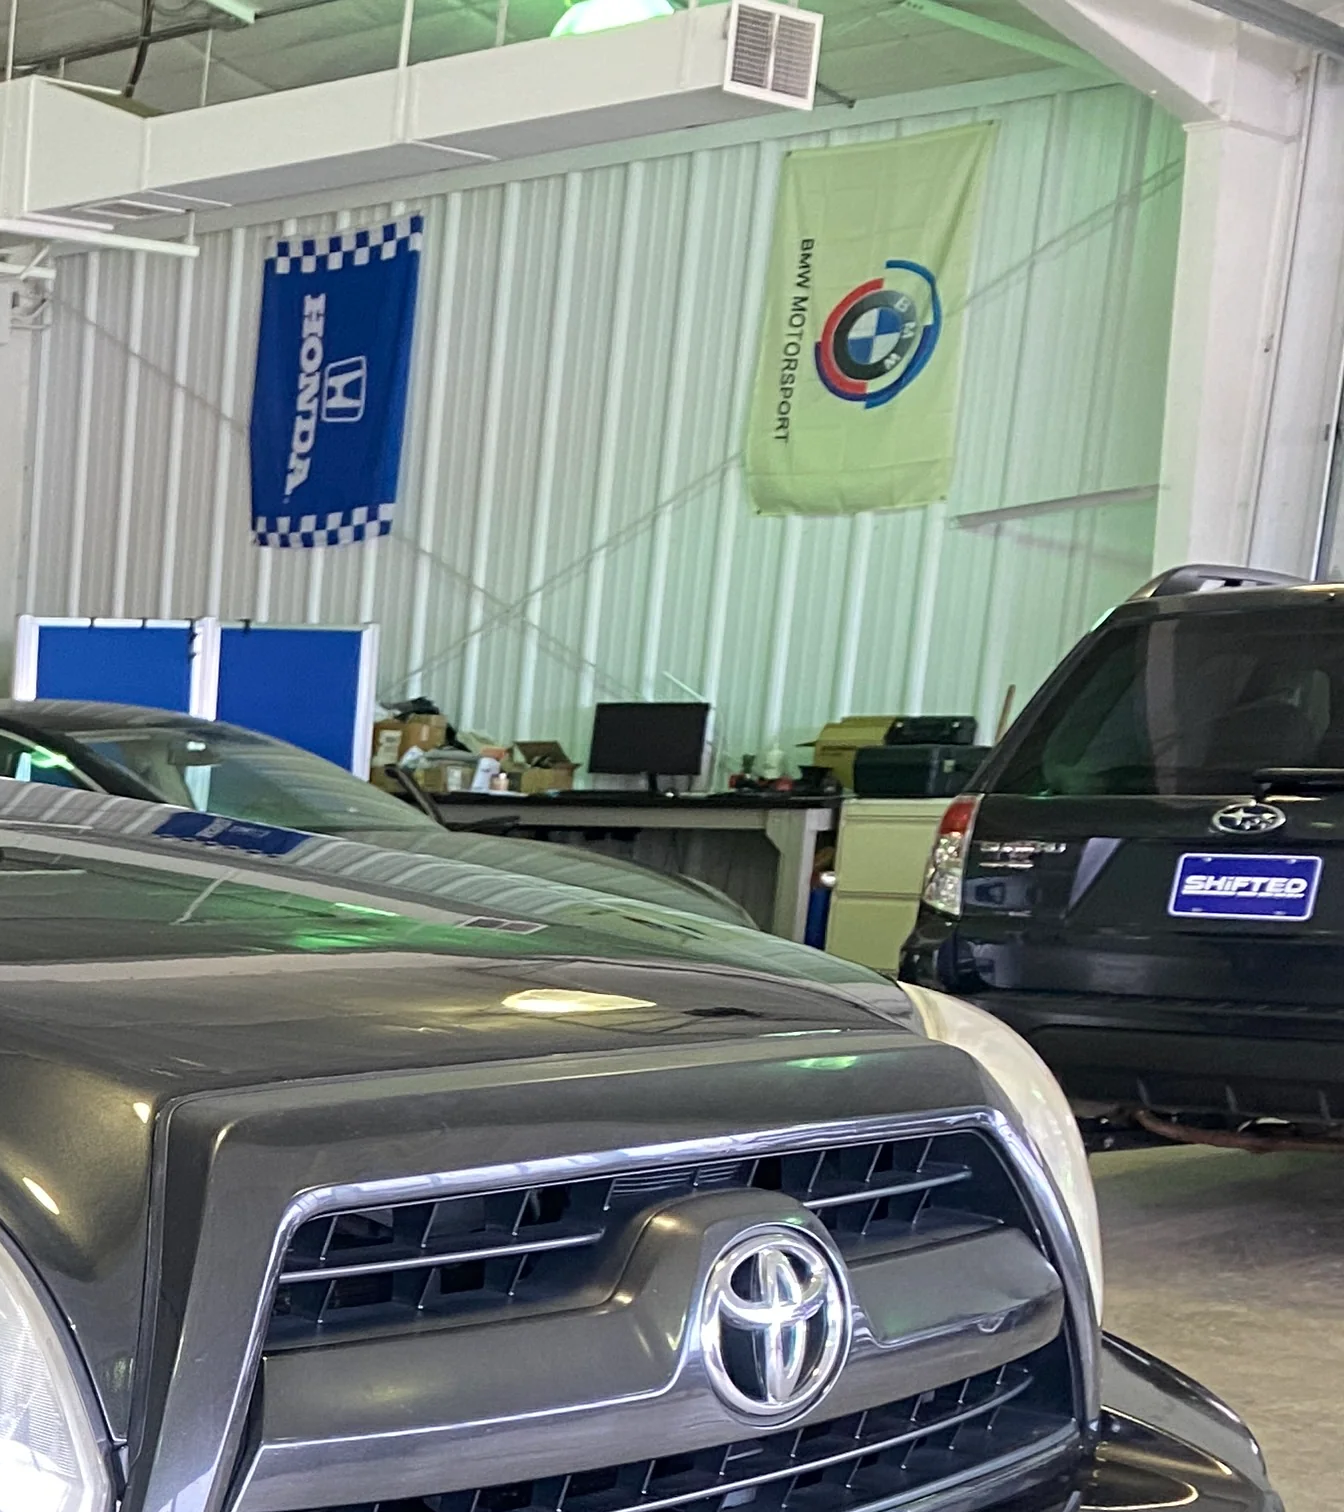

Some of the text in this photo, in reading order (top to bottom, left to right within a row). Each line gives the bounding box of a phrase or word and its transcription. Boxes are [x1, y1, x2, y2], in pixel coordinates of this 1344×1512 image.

[284, 293, 327, 500] HONDA
[773, 237, 815, 444] BMW MOTORSPORT
